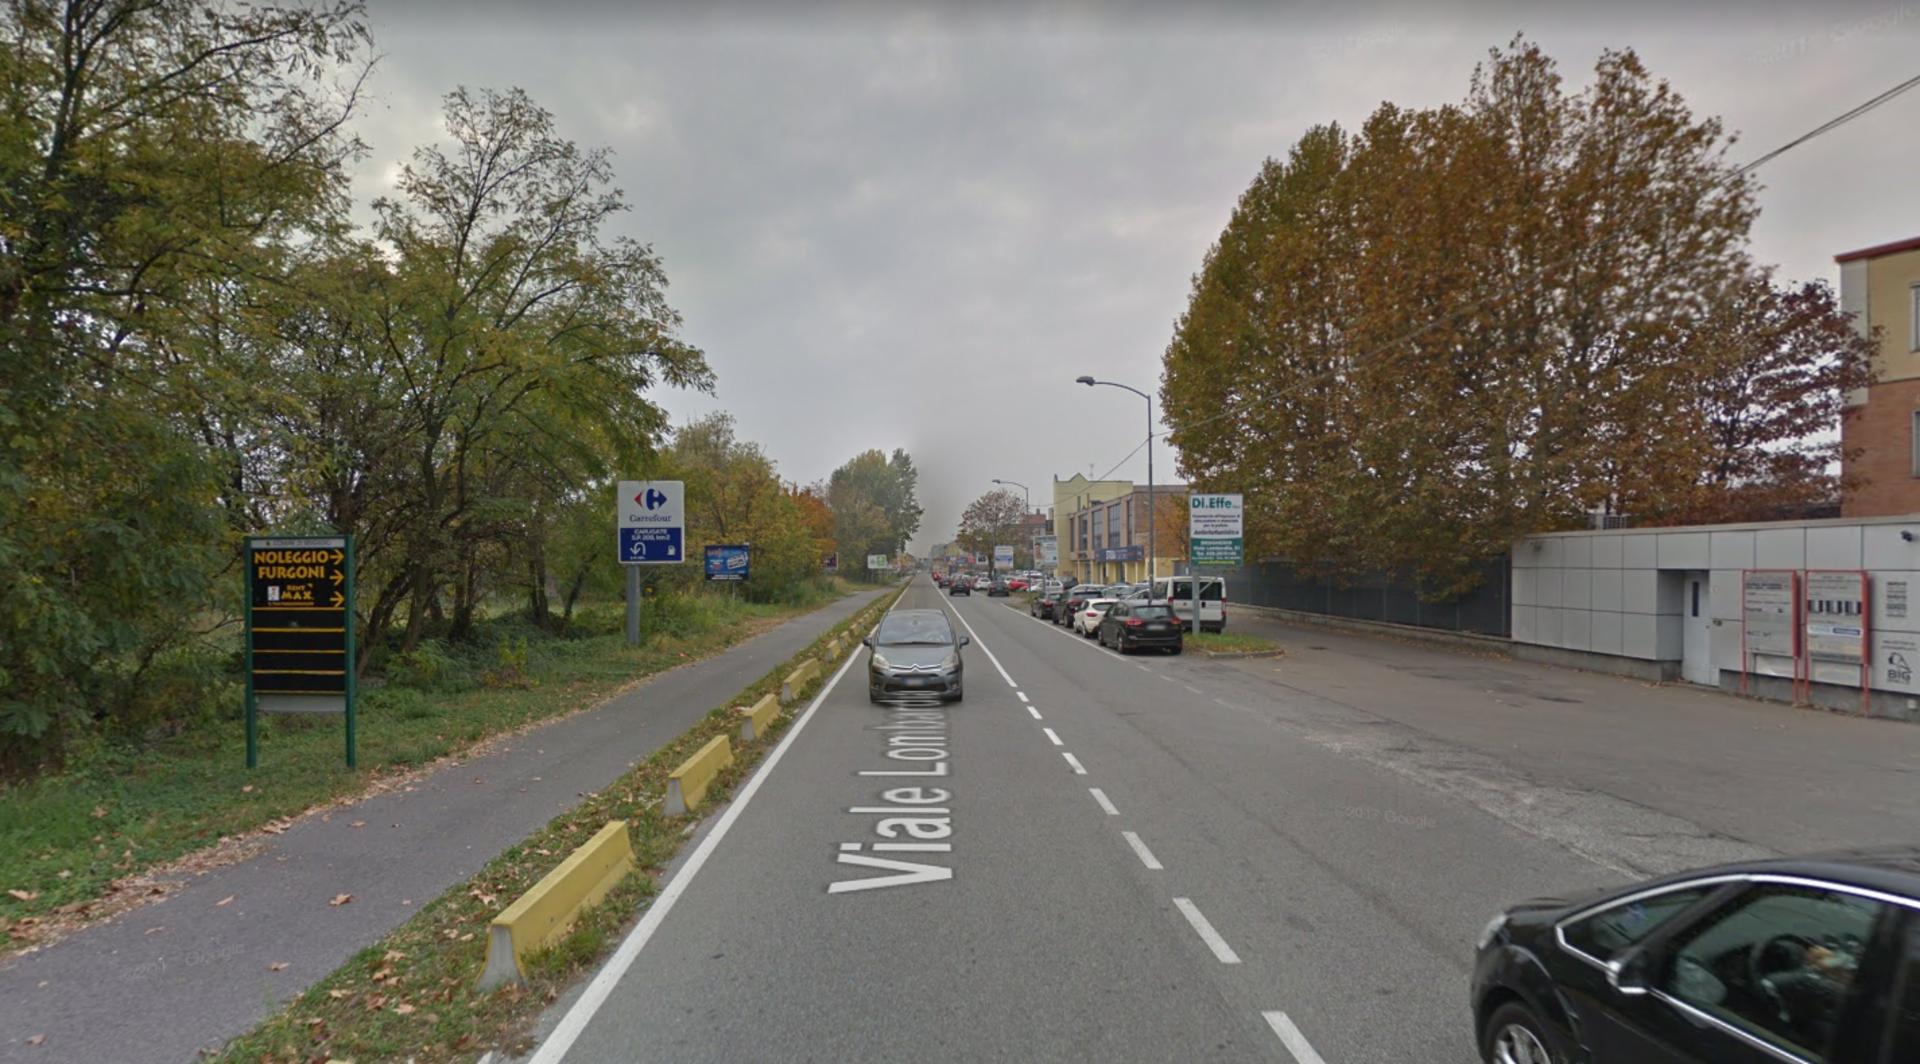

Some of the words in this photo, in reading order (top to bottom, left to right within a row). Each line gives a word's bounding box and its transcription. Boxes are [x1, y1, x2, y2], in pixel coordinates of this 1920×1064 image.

[629, 514, 672, 522] Carrefour
[254, 551, 329, 564] NOLEGGIO
[258, 566, 325, 579] FURGONI
[281, 591, 312, 600] MAX
